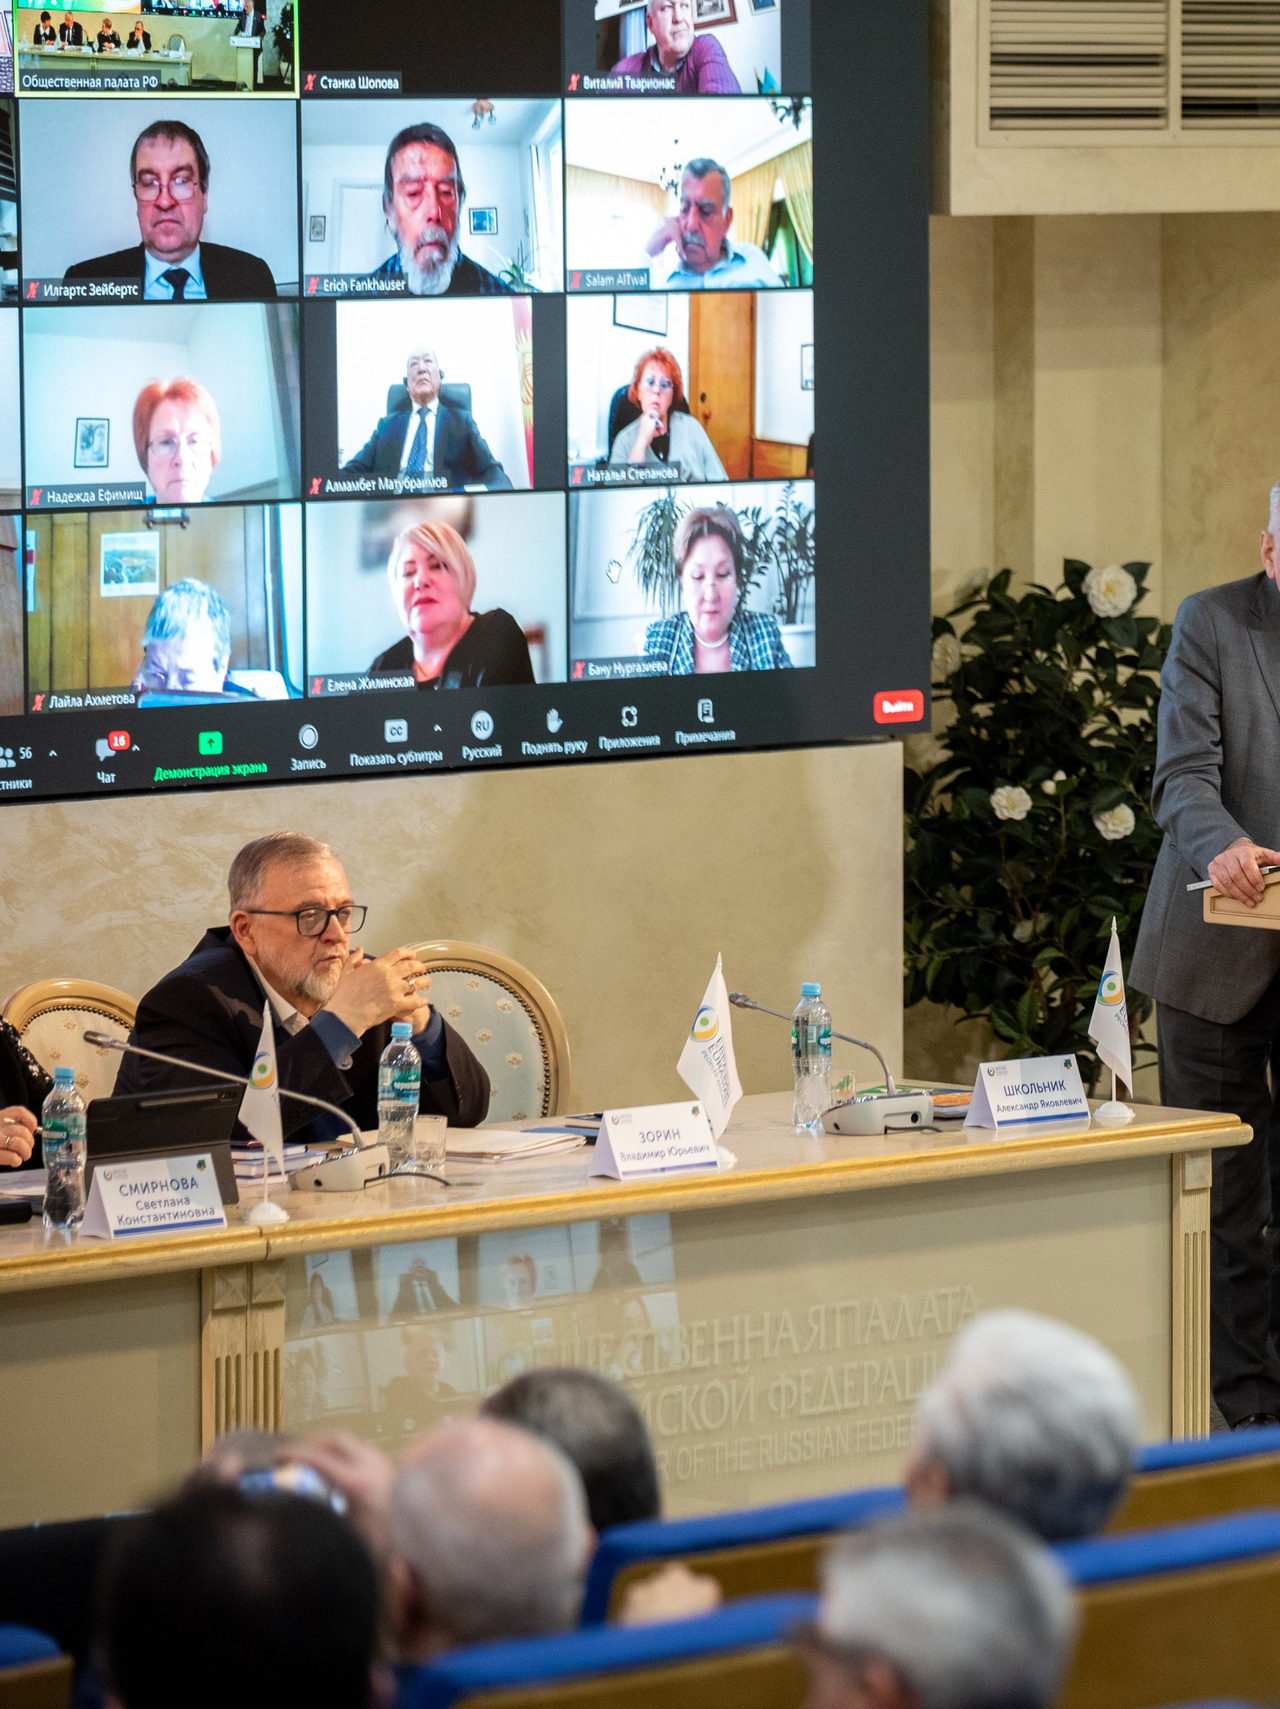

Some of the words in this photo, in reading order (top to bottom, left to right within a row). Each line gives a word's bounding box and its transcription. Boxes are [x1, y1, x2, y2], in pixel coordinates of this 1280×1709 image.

[22, 75, 102, 90] Общественная
[104, 77, 138, 89] палата
[142, 76, 158, 89] РФ
[320, 77, 356, 89] Станка
[359, 77, 399, 89] Шопова
[583, 76, 623, 89] Виталий
[625, 76, 675, 92] Тварионас
[323, 278, 347, 292] Erich
[350, 278, 406, 292] Fankhauser
[585, 274, 614, 287] Salam
[617, 273, 647, 287] AlTwal
[44, 284, 86, 298] Илгартс
[88, 282, 138, 297] Зейбертс
[587, 468, 627, 482] Наталья
[628, 466, 678, 481] Степанова
[325, 479, 377, 494] Алмамбет
[47, 490, 95, 504] Надежда
[588, 662, 612, 677] Бану
[614, 659, 668, 676] Нургазиева
[327, 678, 358, 692] Елена
[360, 675, 415, 690] Жилинская
[49, 694, 83, 709] Лайла
[85, 693, 135, 706] Ахметова
[475, 720, 490, 733] RU
[112, 735, 126, 747] 16
[599, 734, 661, 751] Приложения
[675, 728, 736, 746] Примечания
[19, 746, 32, 760] 56
[462, 742, 503, 760] Русский
[521, 741, 563, 756] Поднять
[565, 738, 588, 754] руку
[291, 756, 326, 771] Запись
[350, 752, 395, 766] Показать
[397, 749, 443, 766] субтитры
[97, 772, 116, 784] Чат
[154, 766, 230, 782] Демонстрация
[231, 763, 268, 777] экрана
[1003, 1079, 1067, 1097] ШКОЛЬНИК
[996, 1101, 1040, 1114] Александр
[1040, 1097, 1083, 1110] Яковлевич
[639, 1128, 681, 1144] ЗОРИН
[620, 1150, 666, 1163] Владимир
[667, 1144, 710, 1159] Юрьевич
[119, 1177, 199, 1197] СМИРНОВА
[136, 1196, 191, 1211] Светлана
[117, 1206, 215, 1226] Константиновна
[676, 1446, 706, 1481] OF
[709, 1437, 753, 1475] THE
[758, 1426, 850, 1468] RUSSIAN
